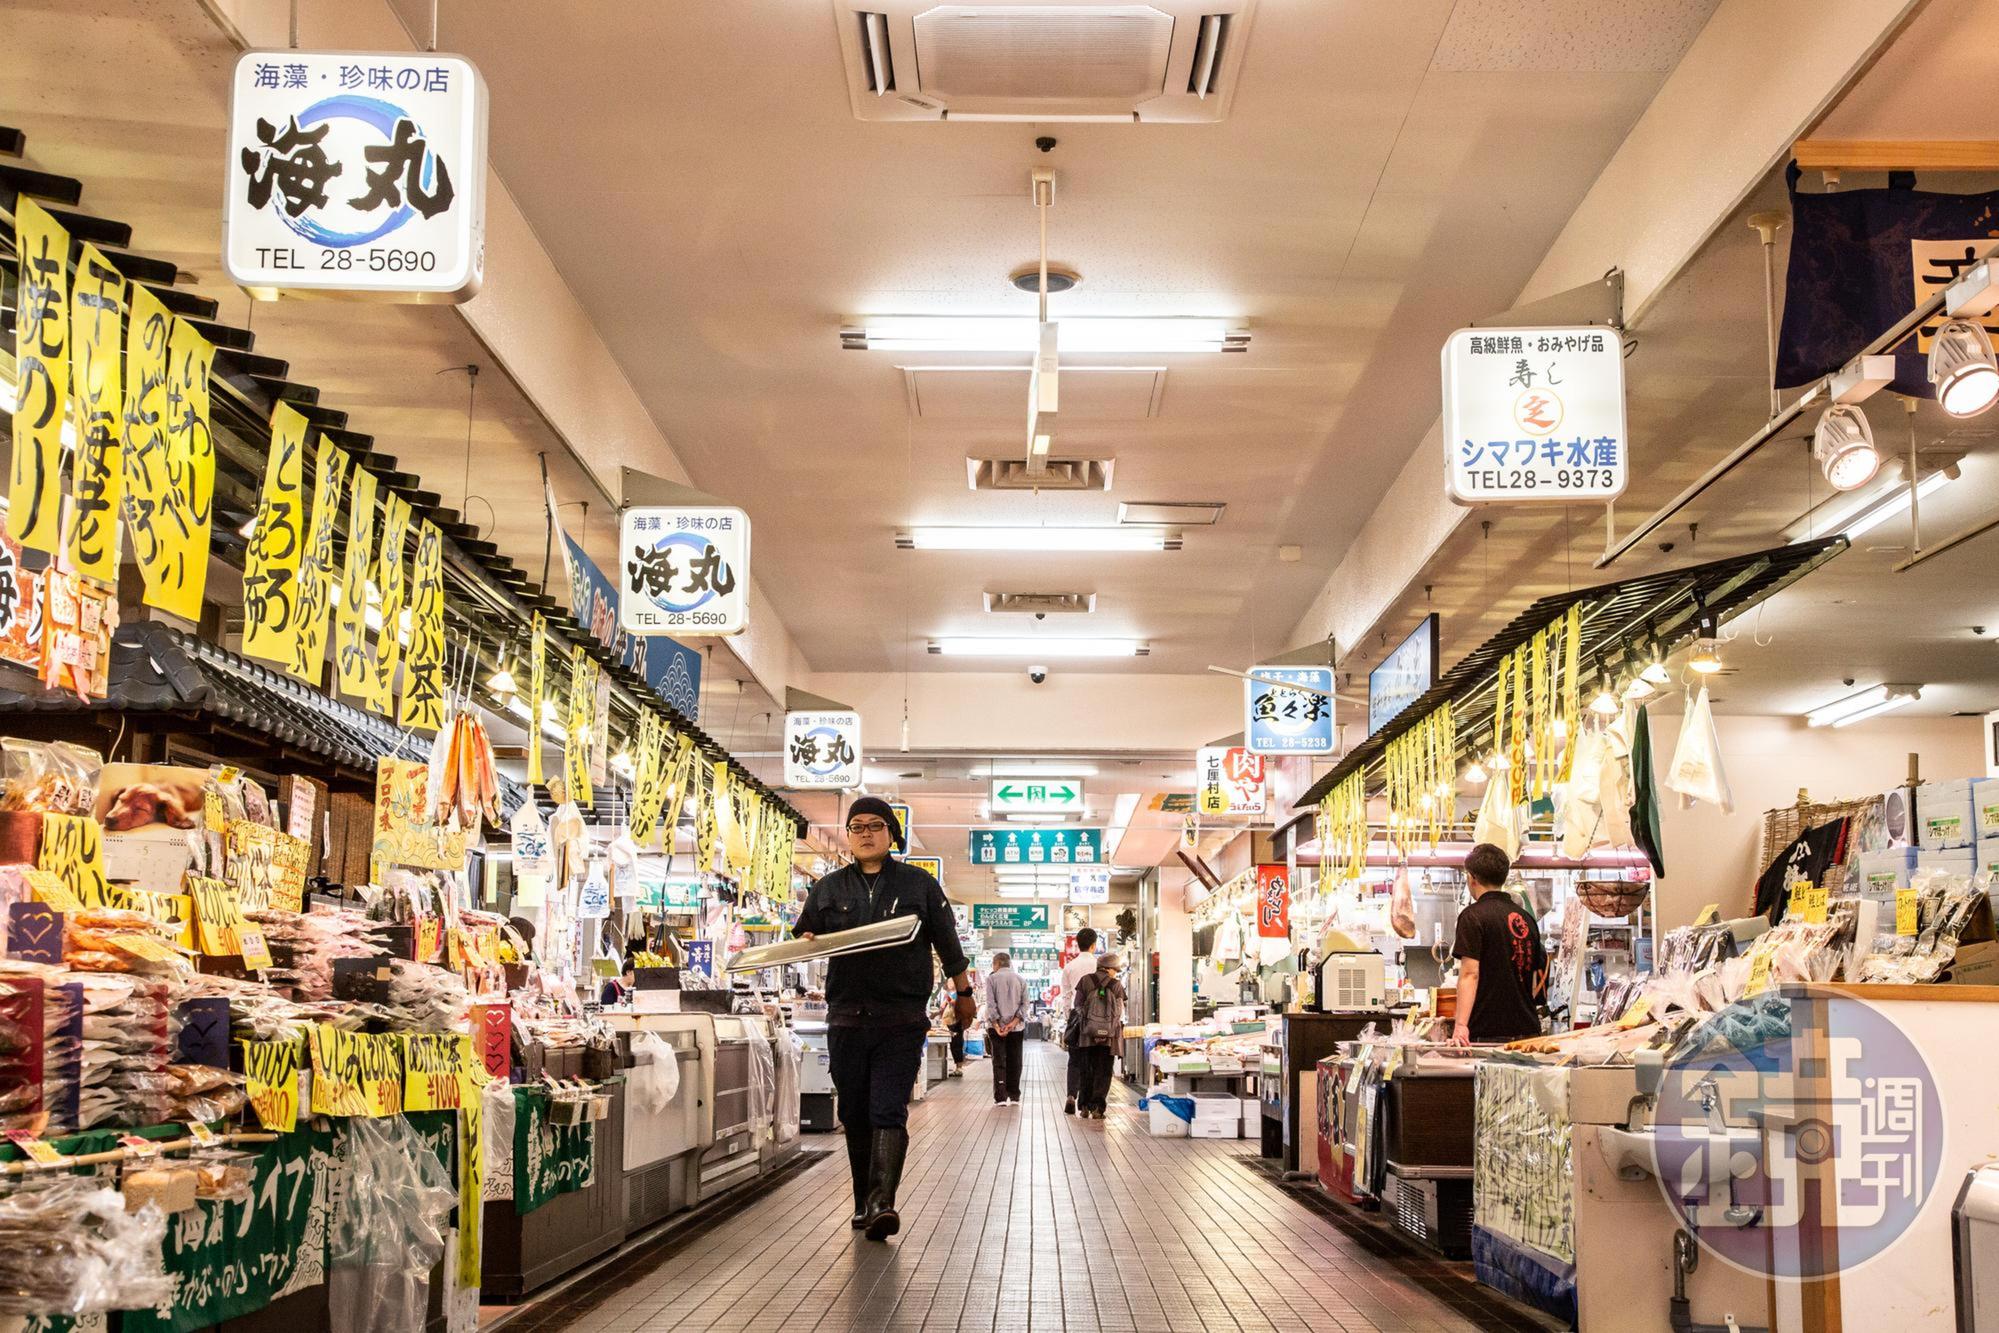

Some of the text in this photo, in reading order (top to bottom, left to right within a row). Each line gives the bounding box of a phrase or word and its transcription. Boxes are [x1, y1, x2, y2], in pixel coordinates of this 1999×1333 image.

[254, 62, 450, 93] 海藻・珍味の店
[241, 114, 455, 220] 海丸
[255, 248, 436, 272] TEL 28-5690
[1470, 335, 1604, 355] 高級鮮魚・おみやげ品
[1461, 436, 1618, 467] シマワキ水産
[633, 516, 733, 531] 海藻・珍味の店
[627, 544, 736, 597] 海丸
[636, 613, 727, 625] TEL 28-5690
[790, 734, 855, 766] 海丸
[1255, 737, 1327, 748] TEL 28-5238
[796, 775, 810, 783] TEL
